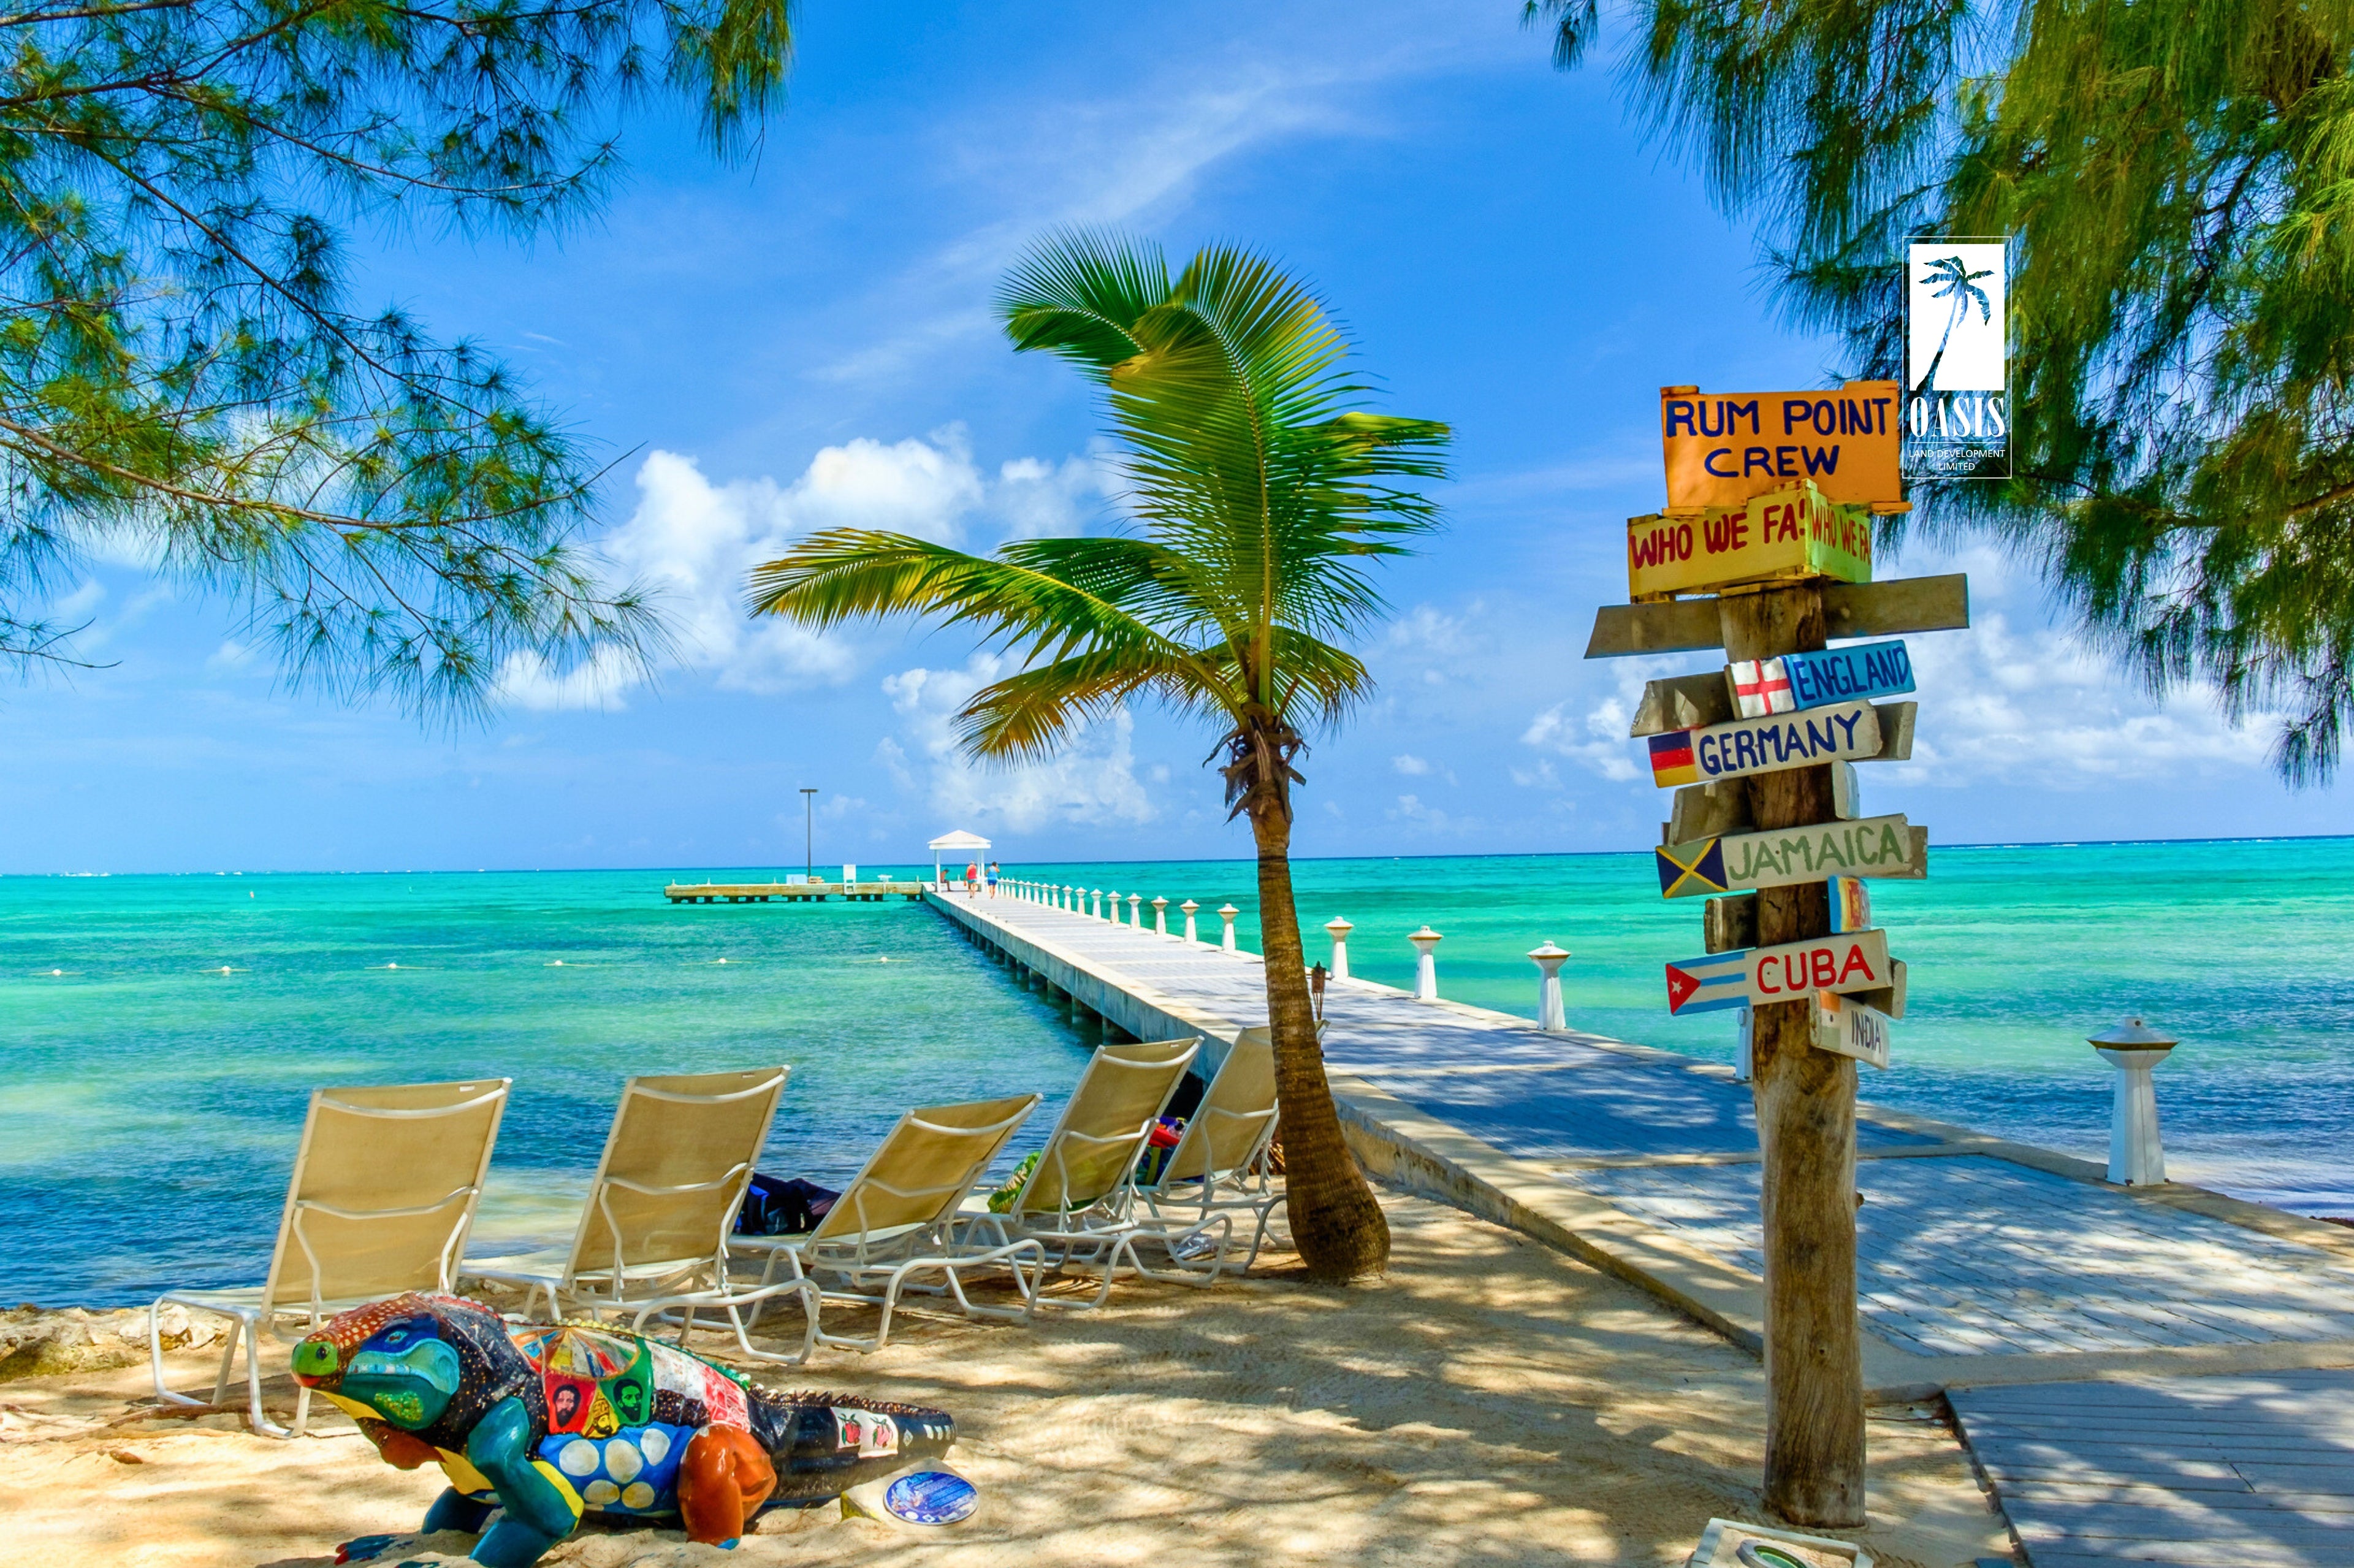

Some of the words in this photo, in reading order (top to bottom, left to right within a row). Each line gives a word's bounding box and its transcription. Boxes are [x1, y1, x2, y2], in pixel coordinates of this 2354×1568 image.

[1666, 400, 1760, 438] RUM
[1783, 398, 1892, 436] POINT
[1705, 445, 1840, 478] CREW
[1630, 523, 1693, 569] WHO
[1703, 512, 1749, 554] WE
[1810, 498, 1837, 550] WHO
[1840, 514, 1857, 557] WE
[1794, 647, 1908, 700] ENGLAND
[1699, 709, 1862, 775] GERMANY
[1728, 823, 1903, 881] JAMAICA
[1757, 944, 1875, 994] CUBA
[1851, 1010, 1882, 1054] INDIA
